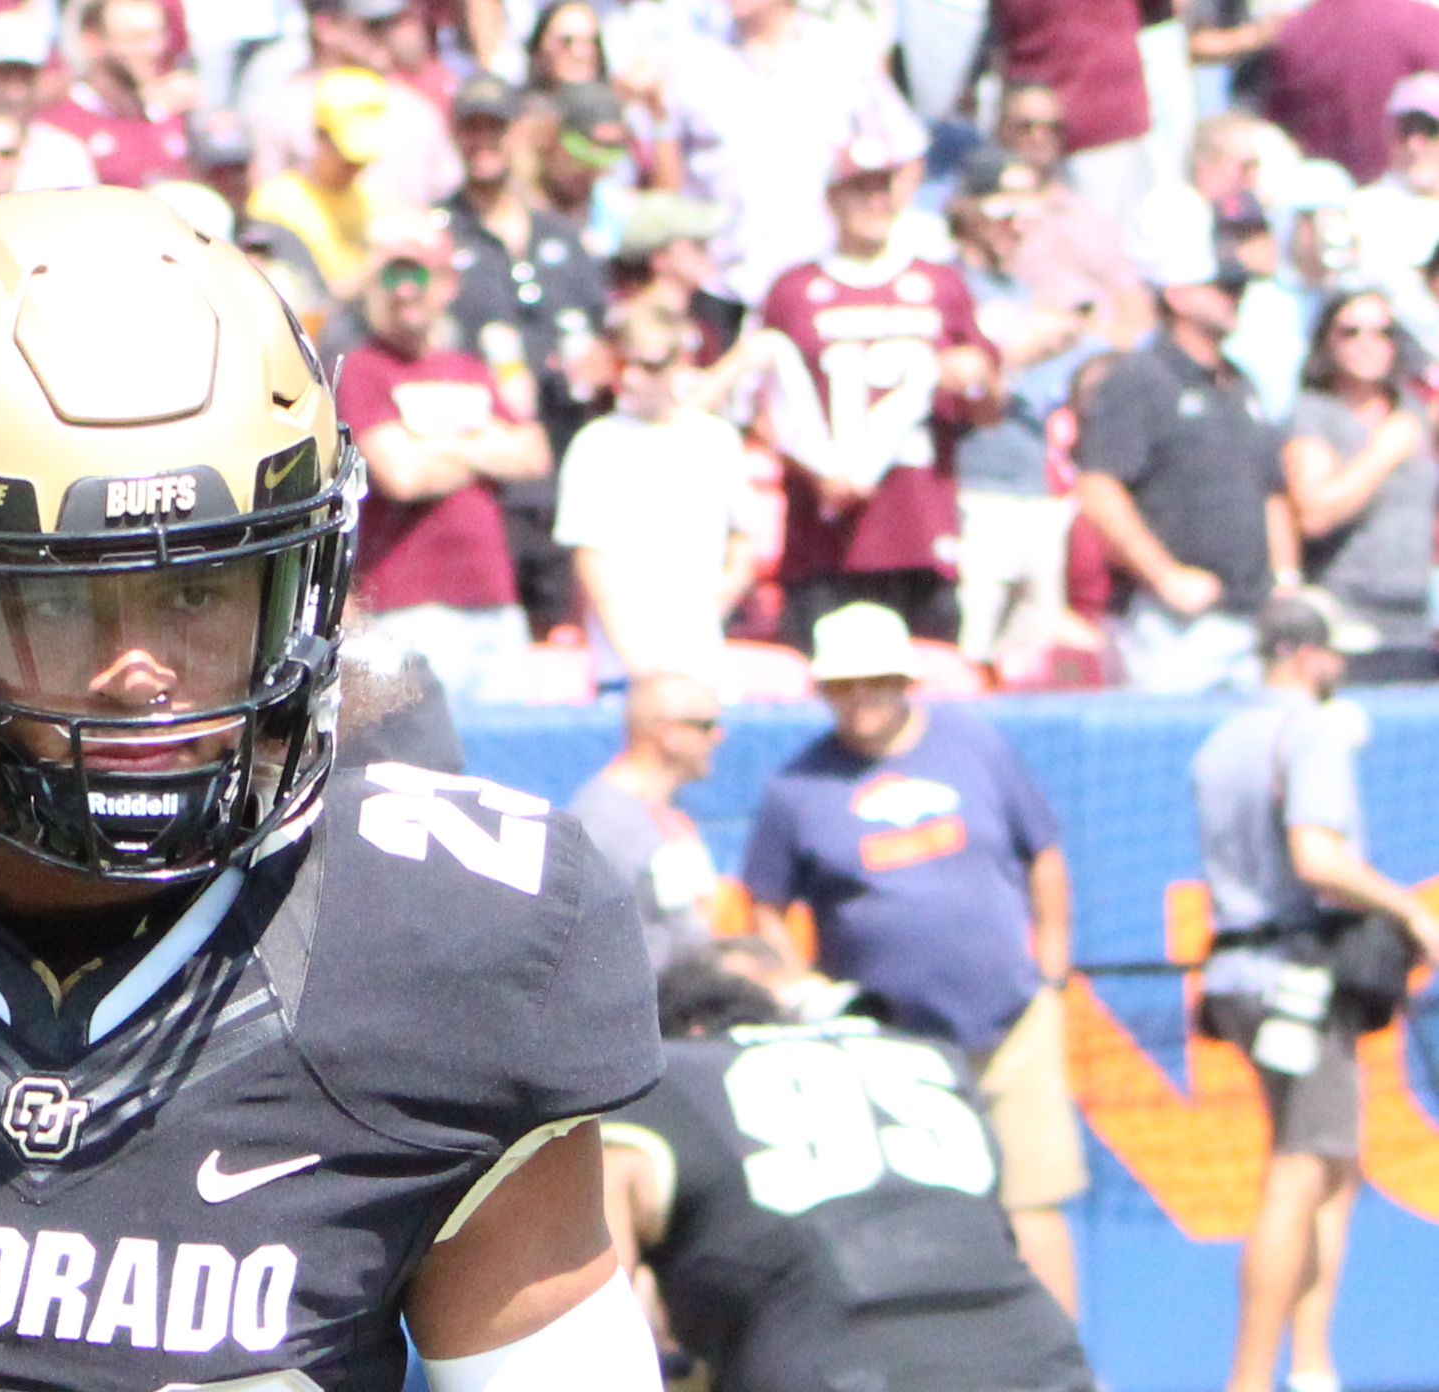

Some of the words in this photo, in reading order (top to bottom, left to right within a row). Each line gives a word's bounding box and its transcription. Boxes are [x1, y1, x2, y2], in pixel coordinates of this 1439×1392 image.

[106, 475, 196, 518] BUFFS
[87, 791, 179, 816] Riddell
[2, 1076, 88, 1160] CU
[723, 1035, 996, 1217] 95
